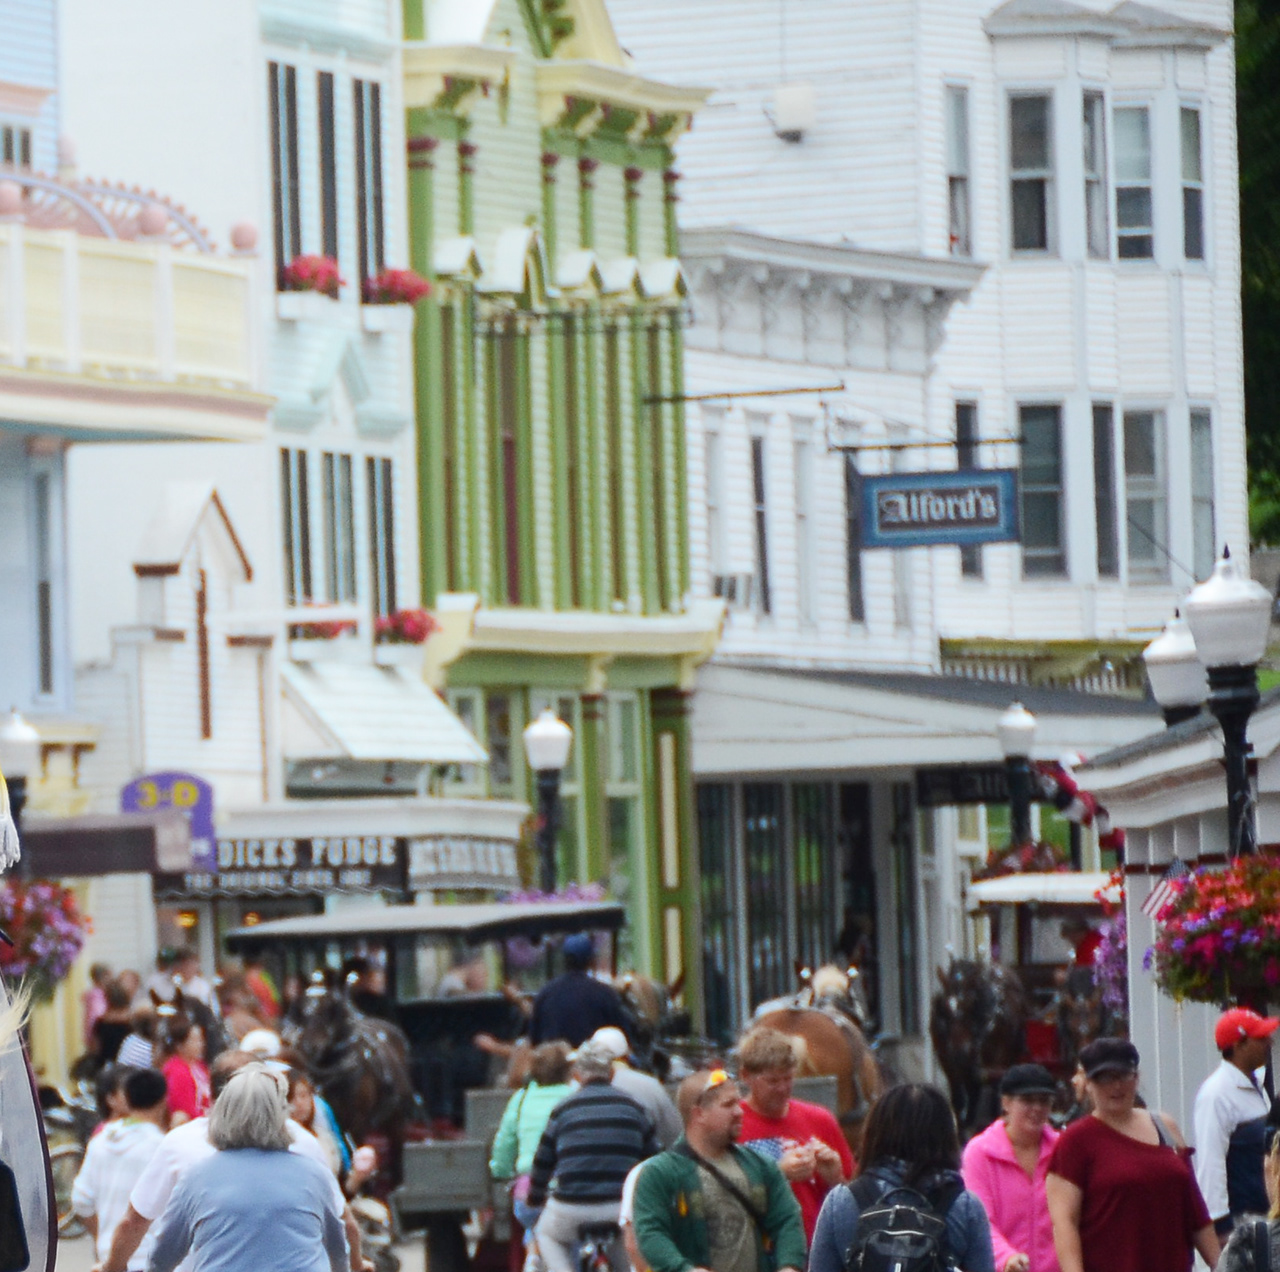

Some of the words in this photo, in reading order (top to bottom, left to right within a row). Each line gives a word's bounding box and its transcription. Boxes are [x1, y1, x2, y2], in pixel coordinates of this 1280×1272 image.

[879, 488, 997, 523] Alford's
[139, 782, 199, 807] 3-D
[312, 836, 396, 867] FUDGE
